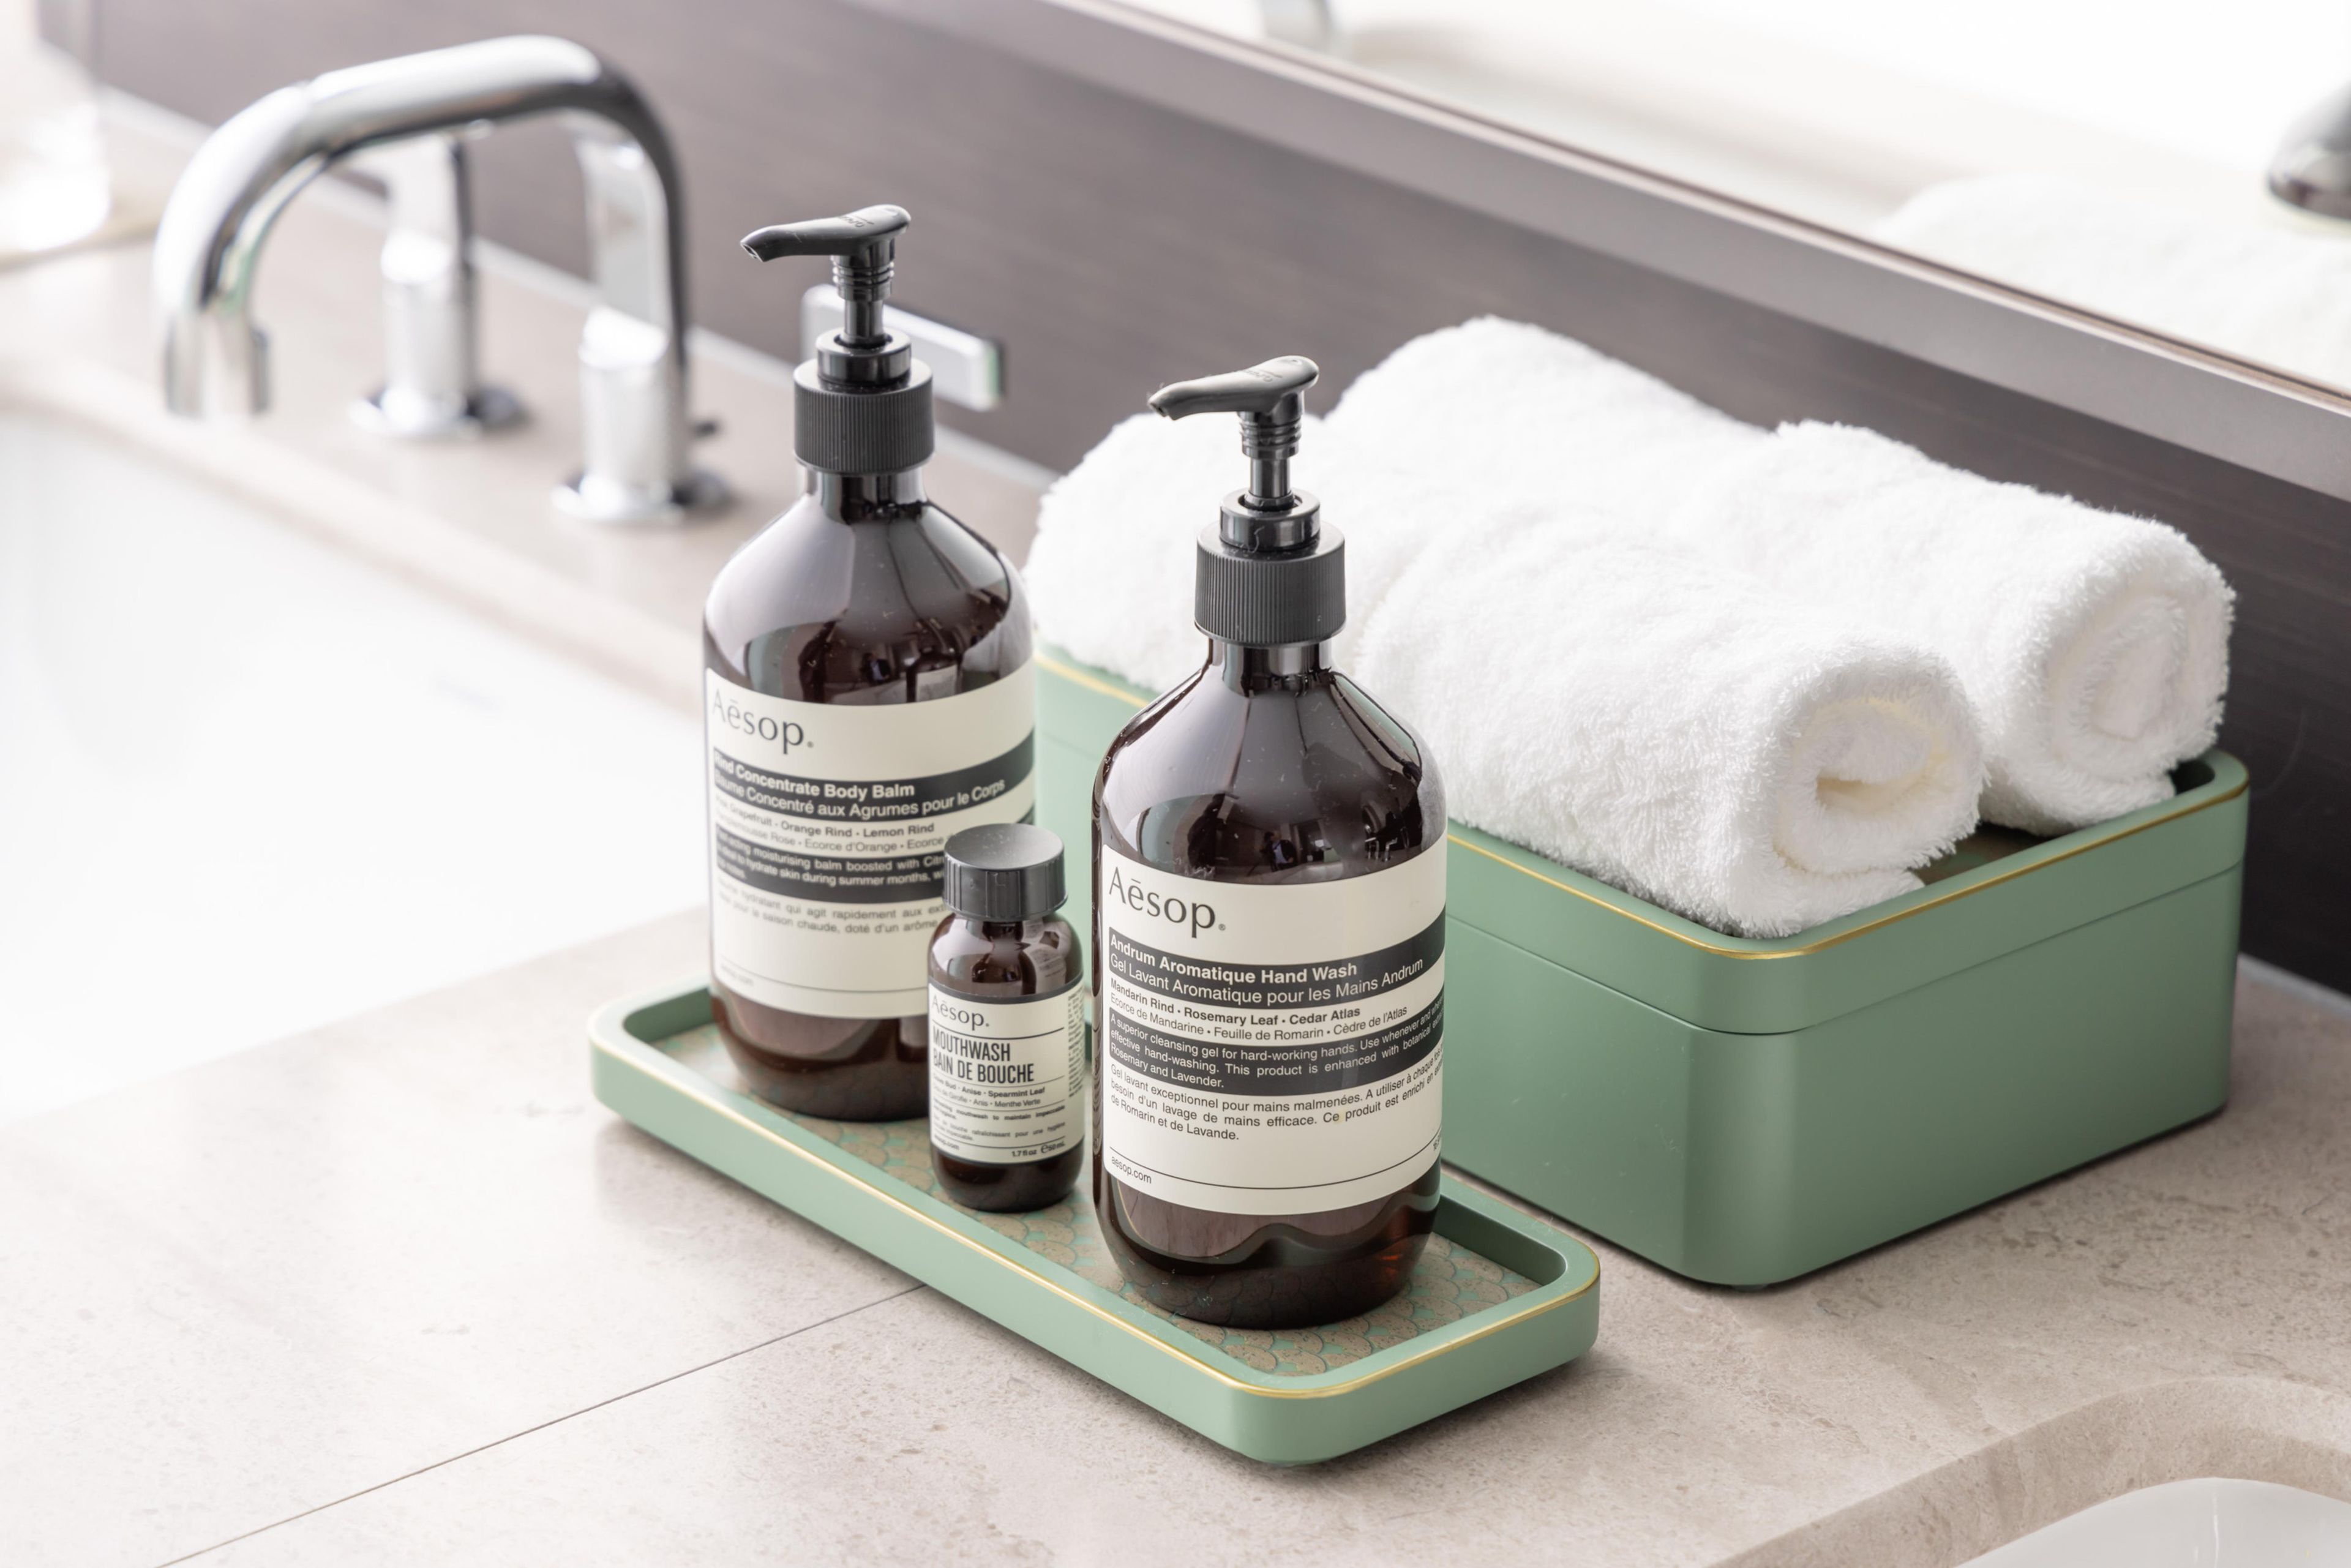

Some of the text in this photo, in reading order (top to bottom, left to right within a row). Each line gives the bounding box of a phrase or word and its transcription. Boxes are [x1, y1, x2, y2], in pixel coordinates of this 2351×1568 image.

[735, 763, 820, 797] Concentrate
[824, 784, 868, 802] Body
[872, 784, 915, 798] Balm
[746, 786, 814, 814] Concentré
[817, 804, 846, 816] aux
[849, 803, 918, 820] Agrumes
[922, 797, 954, 816] pour
[957, 792, 969, 805] le
[971, 779, 1006, 801] Corps
[781, 820, 821, 836] Orange
[825, 827, 852, 837] Rind
[863, 828, 904, 838] Lemon
[909, 823, 934, 835] Rind
[805, 838, 842, 851] Ecorce
[907, 837, 943, 849] Ecorce
[779, 868, 800, 880] skin
[802, 872, 836, 887] during
[839, 876, 884, 886] summer
[887, 871, 931, 884] months,
[814, 860, 842, 871] balm
[847, 861, 893, 872] boosted
[897, 858, 920, 869] with
[807, 908, 826, 918] agit
[833, 909, 896, 920] rapidement
[1111, 934, 1357, 985] Andrum Aromatique Hand Wash
[1111, 953, 1423, 1007] Gel Lavant Aromatique pour les Mains Andrum
[1111, 977, 1360, 1027] Mandarin Rind Rosemary Leaf Cedar Atlas
[1111, 992, 1408, 1040] Ecorce de Mandarine Feuille de Romarin Cèdre de l'Atlas
[933, 1025, 1010, 1062] MOUTHWASH
[1111, 1013, 1116, 1024] A
[1117, 1018, 1149, 1040] superior
[1150, 1035, 1198, 1057] cleansing
[1201, 1047, 1218, 1059] gel
[1222, 1048, 1237, 1059] for
[1240, 1049, 1318, 1061] hard-working
[1321, 1045, 1357, 1057] hands.
[1360, 1038, 1379, 1050] Use
[1382, 1019, 1419, 1044] whenever
[1420, 1008, 1431, 1026] and
[1111, 1030, 1140, 1052] effective
[1145, 1046, 1219, 1074] hand-washing.
[1224, 1063, 1250, 1075] This
[1257, 1065, 1302, 1078] product
[1308, 1063, 1318, 1073] is
[1324, 1052, 1377, 1071] enhanced
[1381, 1045, 1399, 1059] with
[1403, 1024, 1431, 1049] botanical
[934, 1048, 953, 1075] BAIN
[958, 1059, 972, 1080] DE
[978, 1063, 1034, 1083] BOUCHE
[1111, 1043, 1224, 1087] Rosemary and Lavender.
[1111, 1063, 1122, 1078] Gel
[1124, 1071, 1149, 1092] lavant
[1151, 1086, 1218, 1108] exceptionnel
[1222, 1101, 1250, 1111] pour
[1253, 1102, 1290, 1112] mains
[1294, 1094, 1363, 1111] malmenées.
[1365, 1089, 1373, 1100] A
[1376, 1078, 1404, 1097] utiliser
[1406, 1073, 1411, 1084] à
[1413, 1059, 1433, 1080] chaque
[988, 1090, 1028, 1098] Spearmint
[1030, 1087, 1046, 1095] Leaf
[1111, 1073, 1433, 1127] besoin d'un lavage de mains efficace. Ce produit est enrichi en
[1111, 1094, 1239, 1140] de Romarin et de Lavande.
[1111, 1156, 1152, 1184] aesop.com
